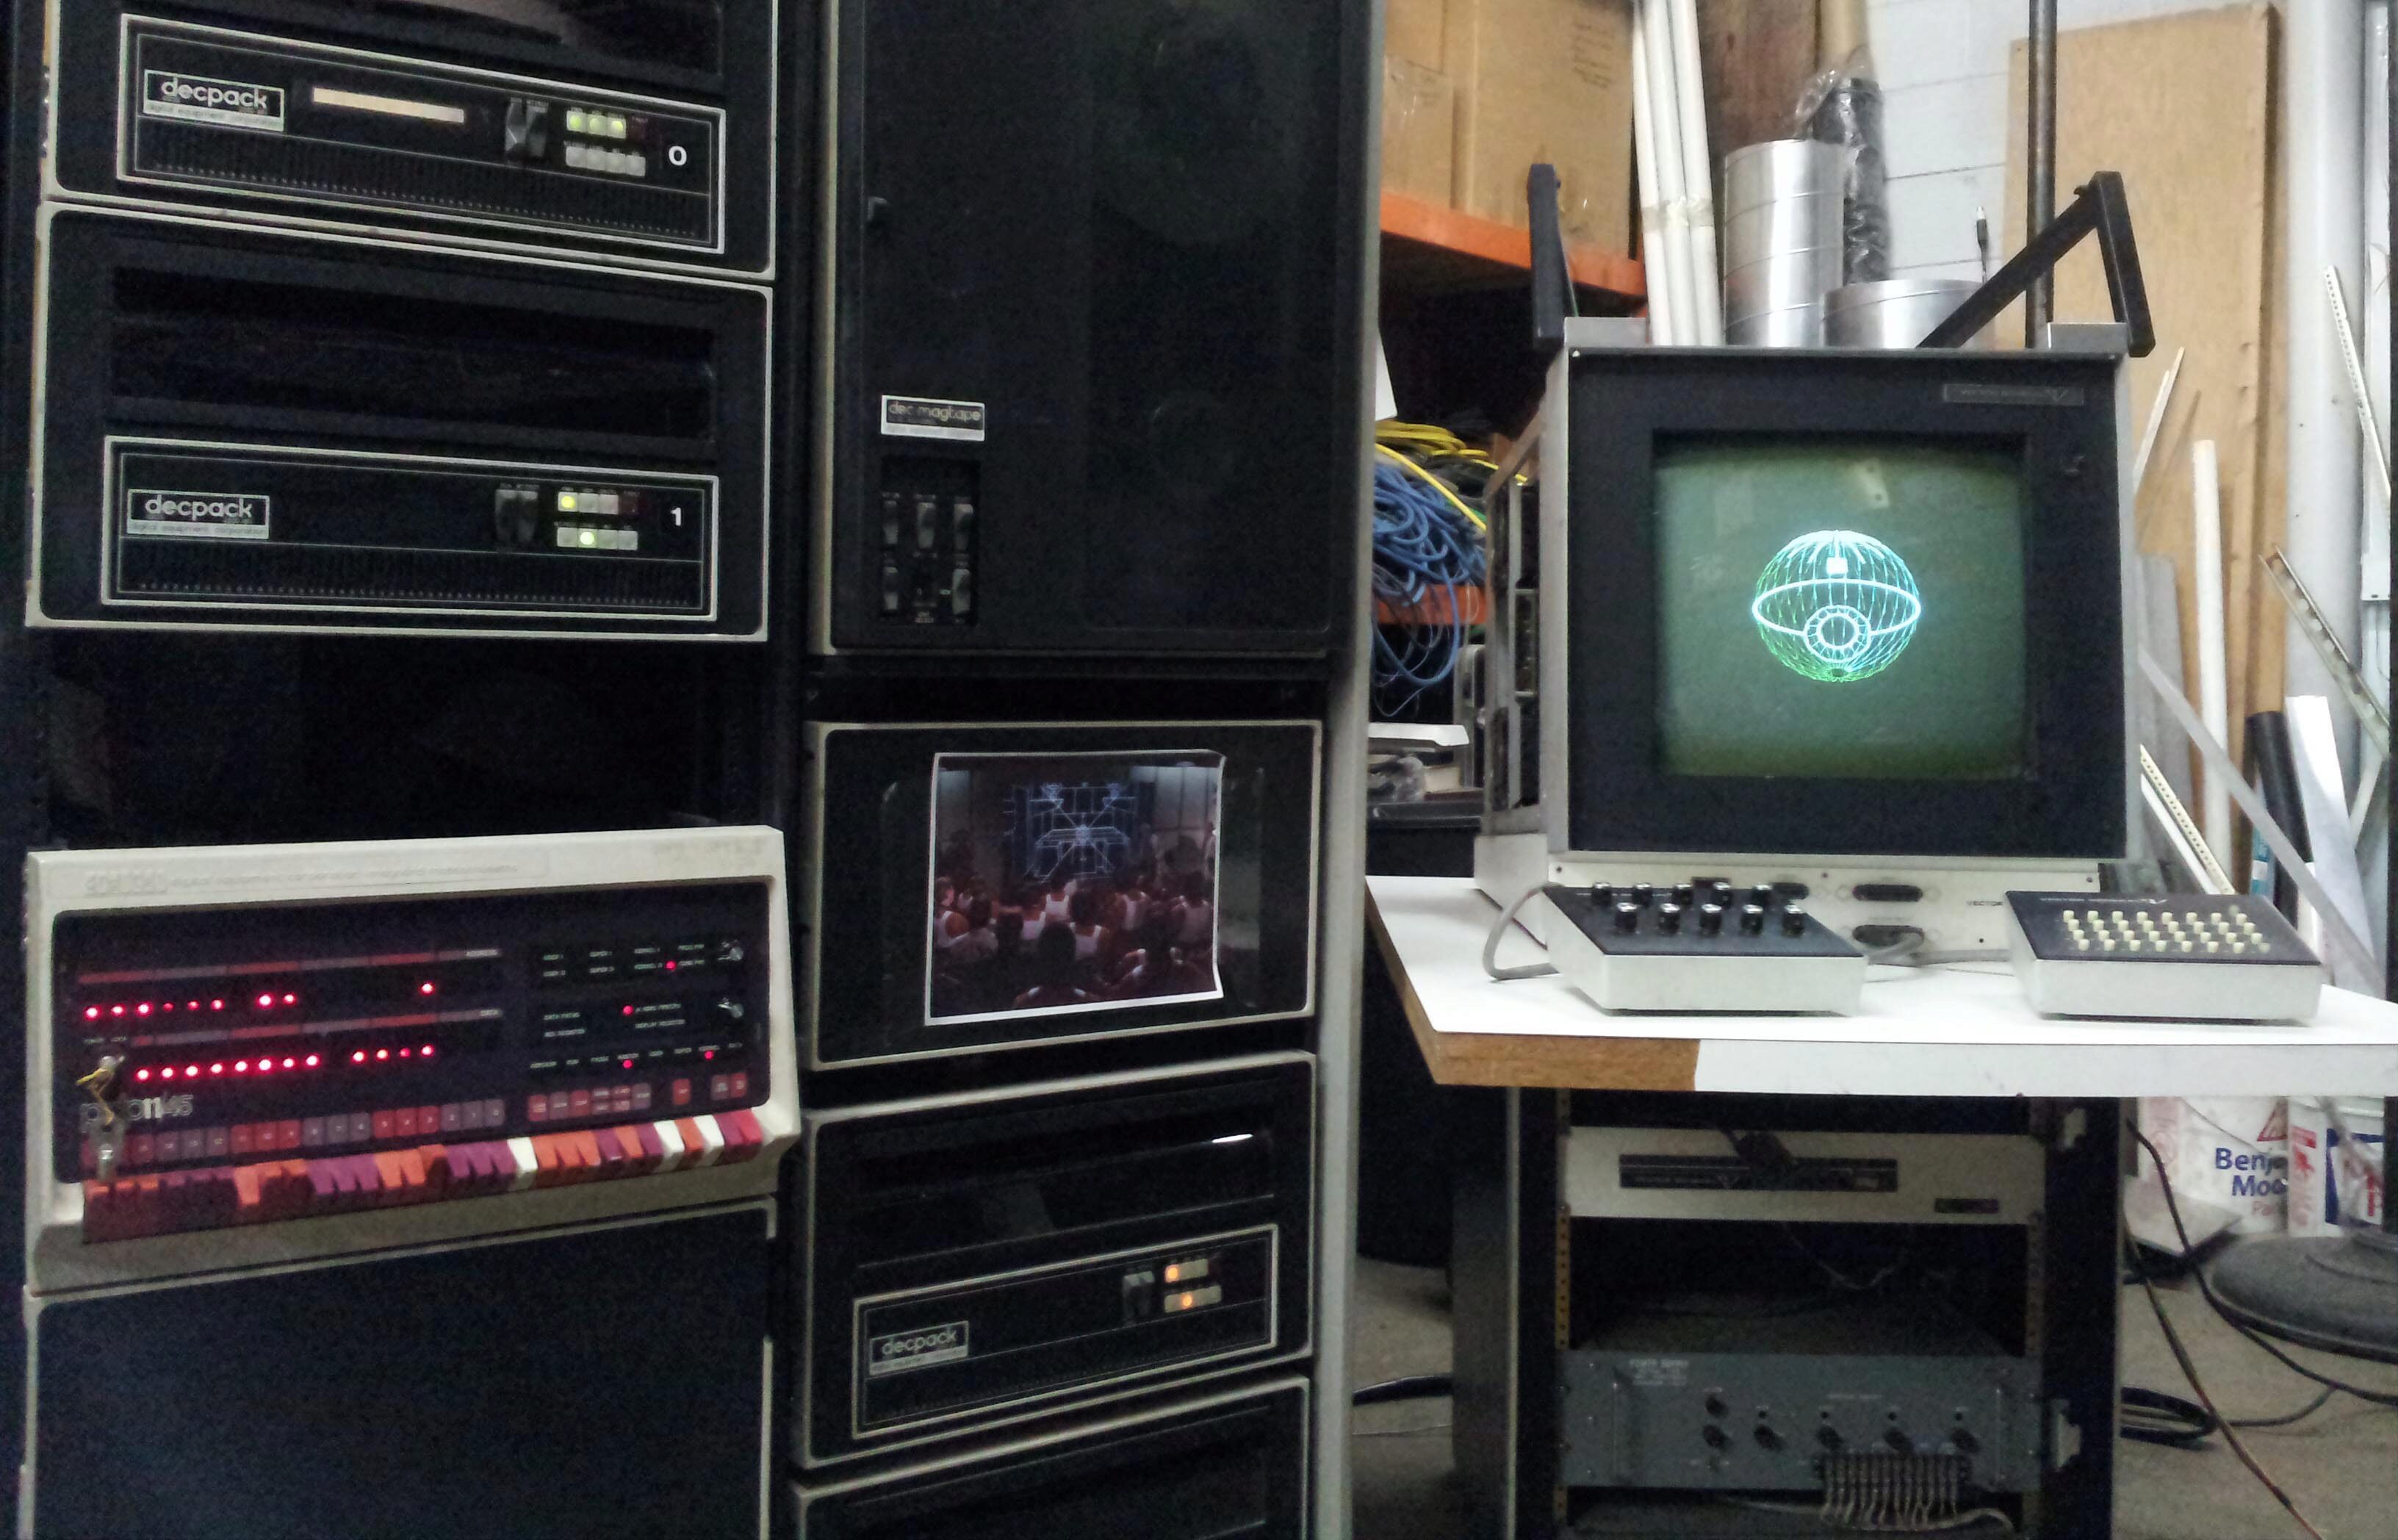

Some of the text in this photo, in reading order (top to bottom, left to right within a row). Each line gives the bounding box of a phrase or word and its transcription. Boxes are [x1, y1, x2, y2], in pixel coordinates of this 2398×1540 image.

[161, 77, 267, 108] decpack
[145, 494, 253, 522] decpack
[670, 507, 682, 526] 1
[882, 1326, 957, 1354] decpack
